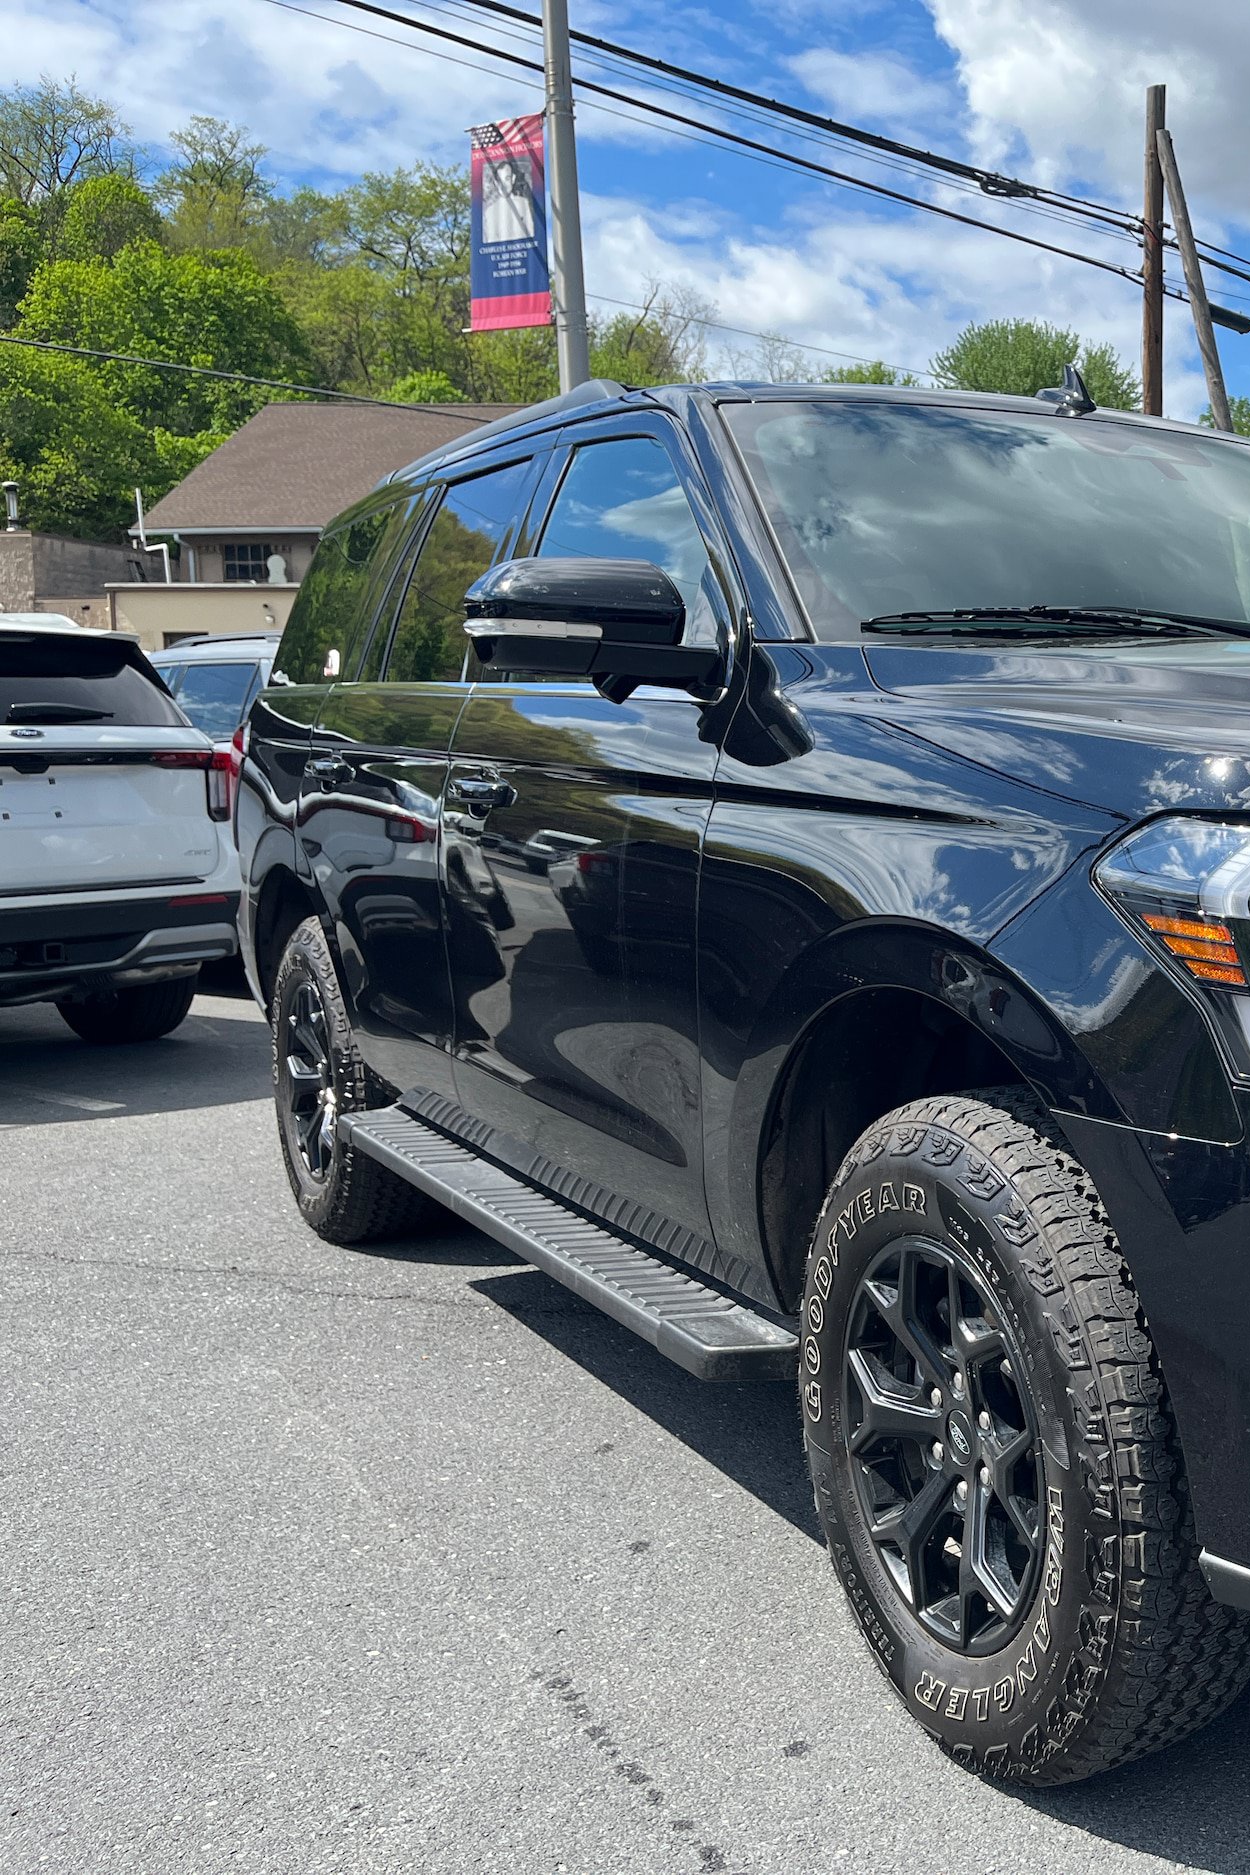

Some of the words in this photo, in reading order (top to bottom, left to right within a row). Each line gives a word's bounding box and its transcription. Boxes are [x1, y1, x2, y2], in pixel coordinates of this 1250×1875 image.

[804, 1181, 927, 1423] GOODYEAR
[834, 1542, 896, 1662] TERRITORY
[914, 1486, 1065, 1723] WRANGLER
